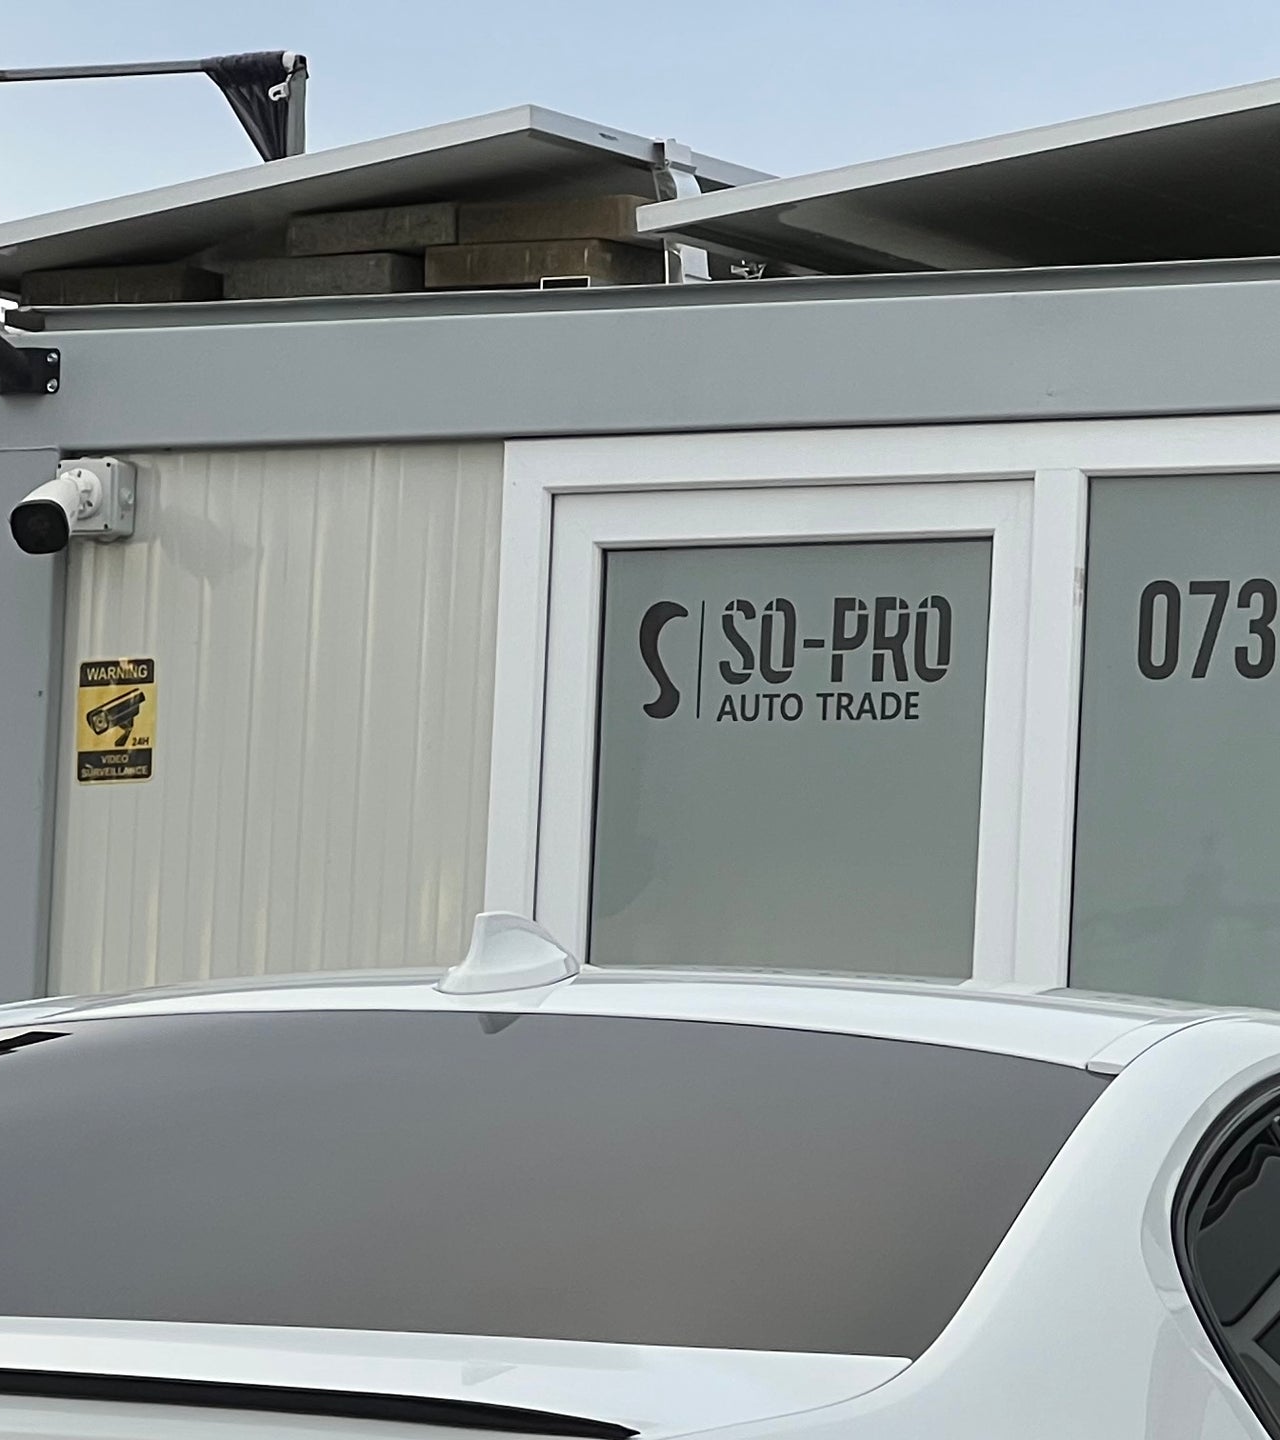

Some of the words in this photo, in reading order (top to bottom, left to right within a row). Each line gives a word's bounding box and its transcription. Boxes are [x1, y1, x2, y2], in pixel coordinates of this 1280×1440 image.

[718, 595, 952, 685] SO-PRO
[86, 664, 148, 681] WARNING
[716, 692, 804, 722] AUTO
[816, 691, 920, 721] TRADE
[132, 737, 150, 747] 24H
[101, 754, 129, 764] VIDEO
[81, 765, 149, 778] SURVEILLANCE
